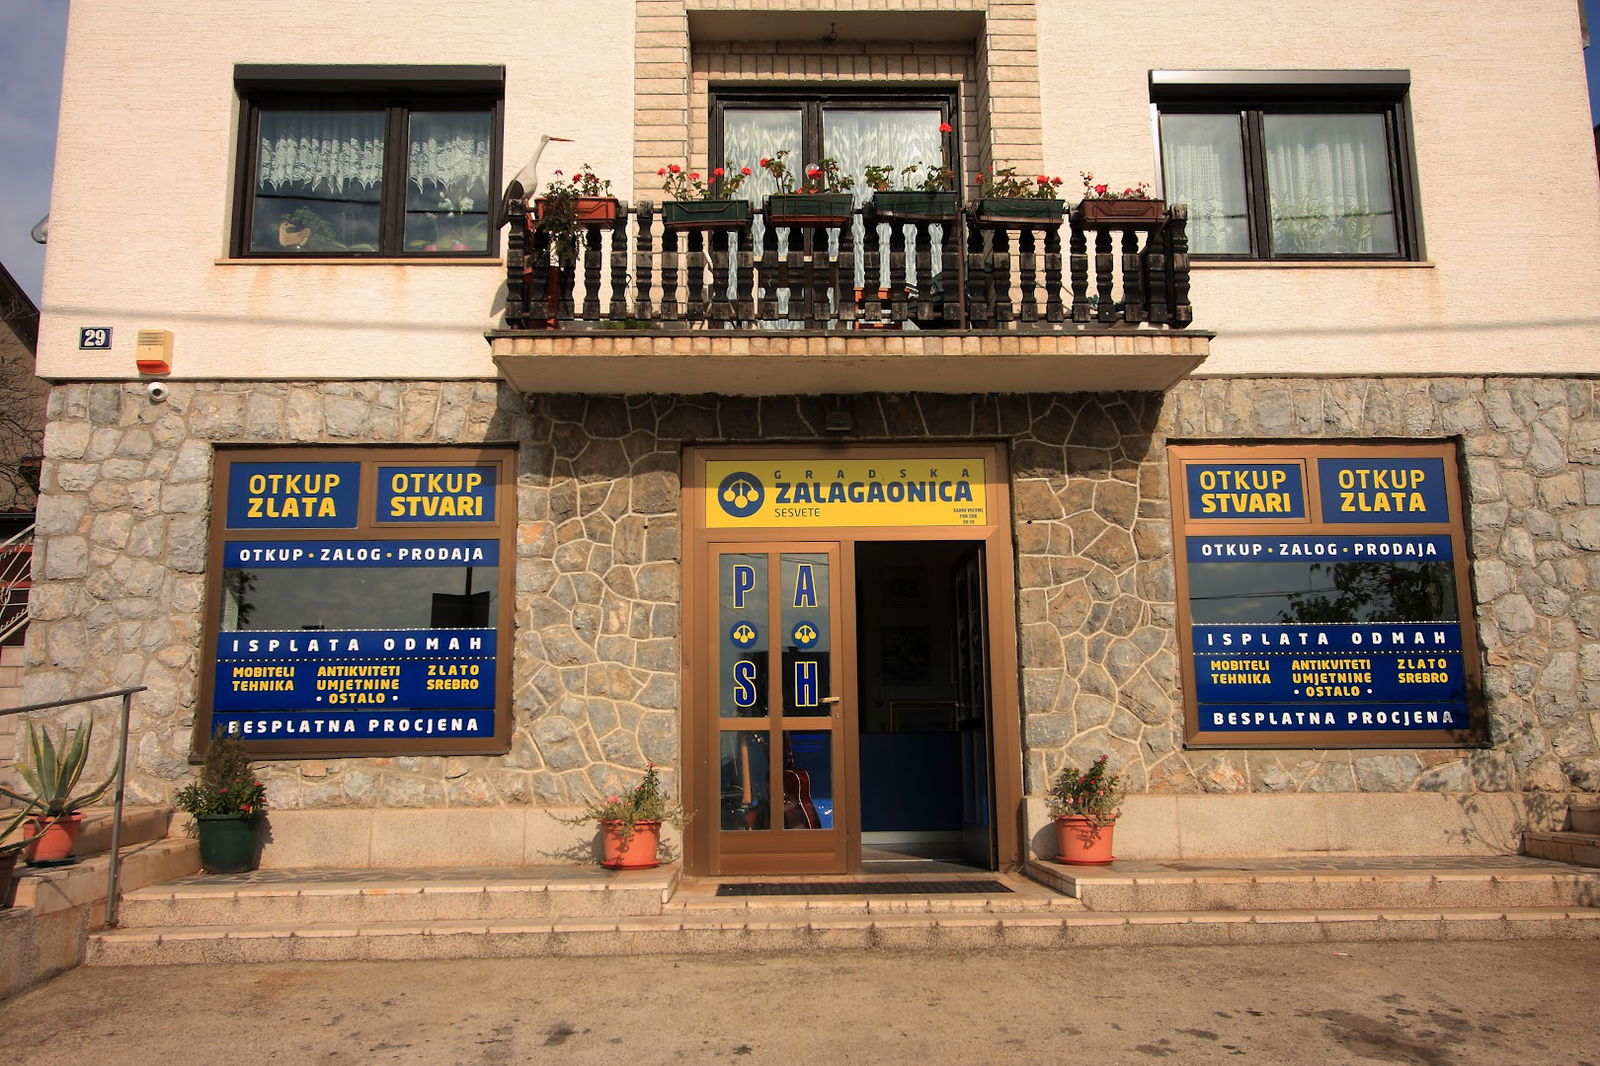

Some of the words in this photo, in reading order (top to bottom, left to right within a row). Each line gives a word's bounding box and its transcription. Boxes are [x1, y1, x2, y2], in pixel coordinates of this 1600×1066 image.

[84, 329, 106, 346] 29
[774, 468, 970, 479] GRADSKA
[1200, 470, 1286, 490] OTKUP
[1339, 470, 1425, 489] OTKUP
[250, 474, 340, 494] OTKUP
[392, 473, 481, 493] OTKUP
[776, 481, 973, 503] ZALAGAONICA
[248, 497, 336, 517] ZLATA
[391, 496, 482, 516] STVARI
[1201, 493, 1291, 513] STVARI
[1340, 492, 1426, 511] ZLATA
[774, 508, 821, 517] SESVETE
[240, 549, 303, 561] OTKUP
[321, 549, 380, 560] ZALOG
[399, 548, 483, 562] PRODAJA
[1202, 544, 1262, 556] OTKUP
[1280, 544, 1337, 555] ZALOG
[1354, 543, 1436, 557] PRODAJA
[233, 639, 359, 651] ISPLATA
[384, 638, 481, 650] ODMAH
[1208, 633, 1328, 645] ISPLATA
[1352, 632, 1445, 644] ODMAH
[428, 665, 479, 675] ZLATO
[1211, 660, 1269, 670] MOBITELI
[1292, 659, 1370, 670] ANTIKVITETI
[1398, 659, 1446, 669] ZLATO
[233, 667, 294, 677] MOBITELI
[318, 666, 400, 676] ANTIKVITETI
[427, 679, 478, 690] SREBRO
[1211, 674, 1271, 684] TEHNIKA
[1293, 673, 1371, 685] UMJETNINE
[1398, 673, 1448, 683] SREBRO
[232, 680, 293, 691] TEHNIKA
[317, 679, 399, 692] UMJETNINE
[1306, 686, 1360, 697] OSTALO
[329, 693, 385, 704] OSTALO
[1214, 713, 1335, 725] BESPLATNA
[1348, 711, 1453, 726] PROCJENA
[228, 720, 355, 733] BESPLATNA
[369, 719, 477, 733] PROCJENA
